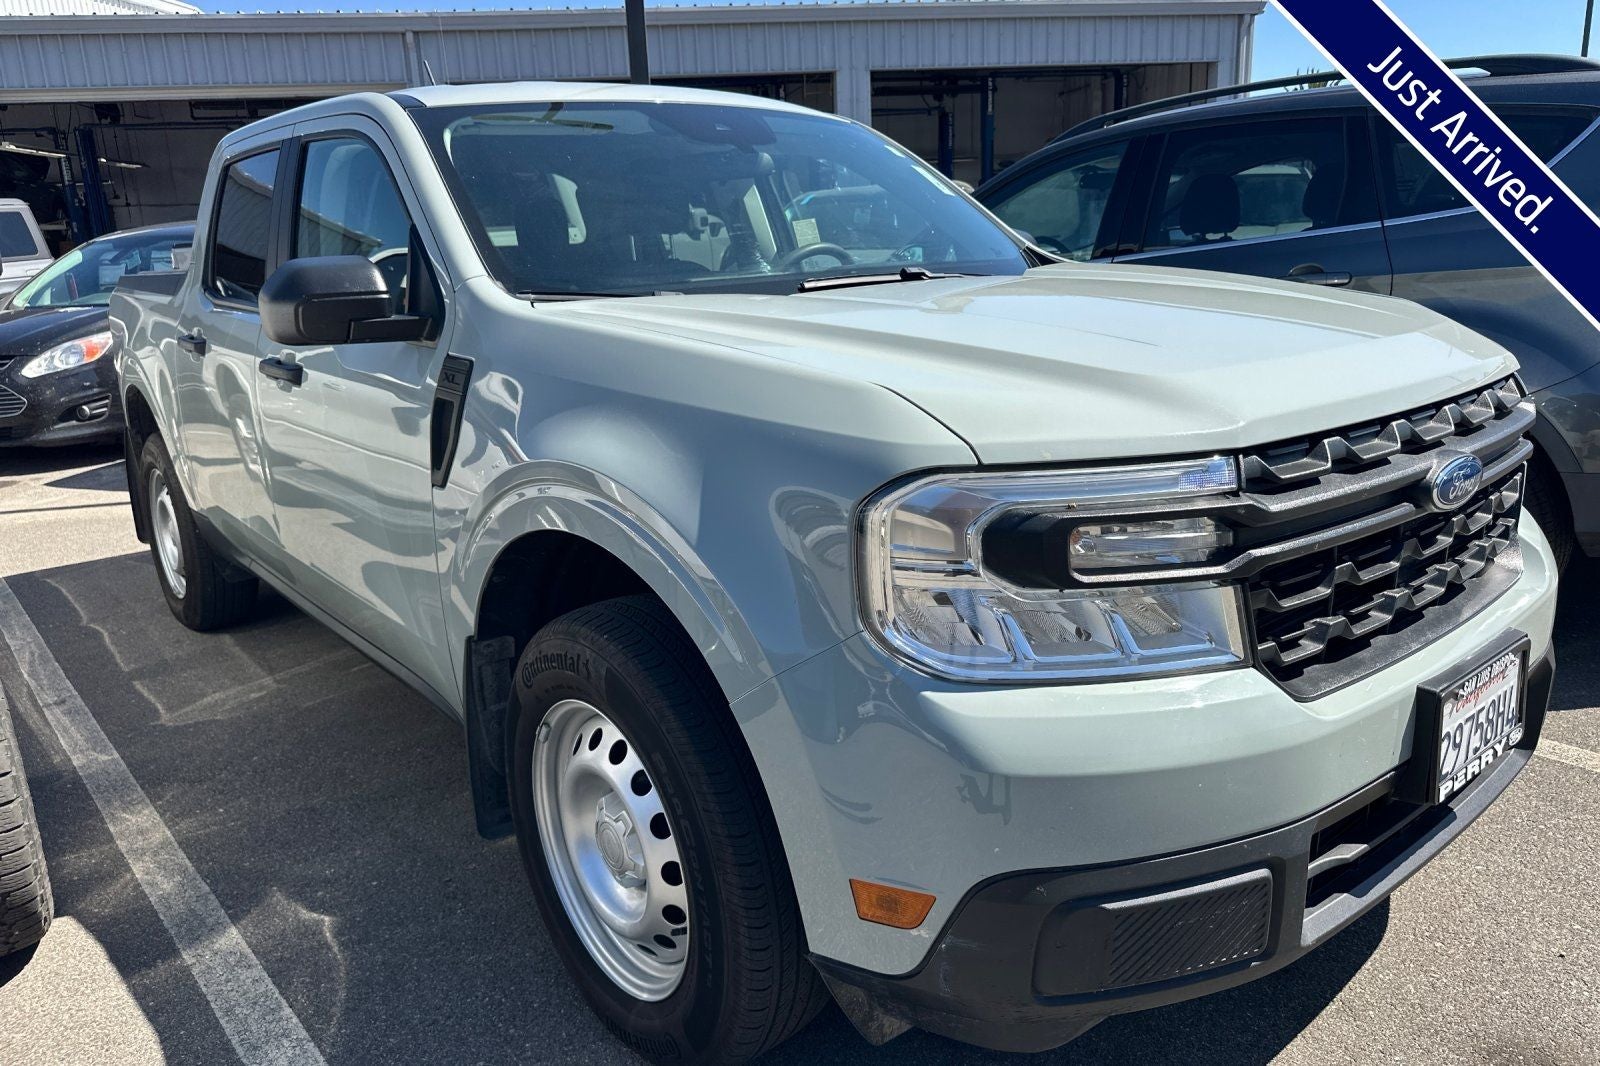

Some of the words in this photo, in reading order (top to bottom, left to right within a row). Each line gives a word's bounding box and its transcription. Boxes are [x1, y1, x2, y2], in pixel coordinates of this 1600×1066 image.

[443, 371, 460, 386] XL
[521, 650, 581, 689] Continental
[1464, 676, 1477, 695] SAN
[1440, 685, 1519, 781] 29758H4
[1439, 736, 1508, 804] PERRY
